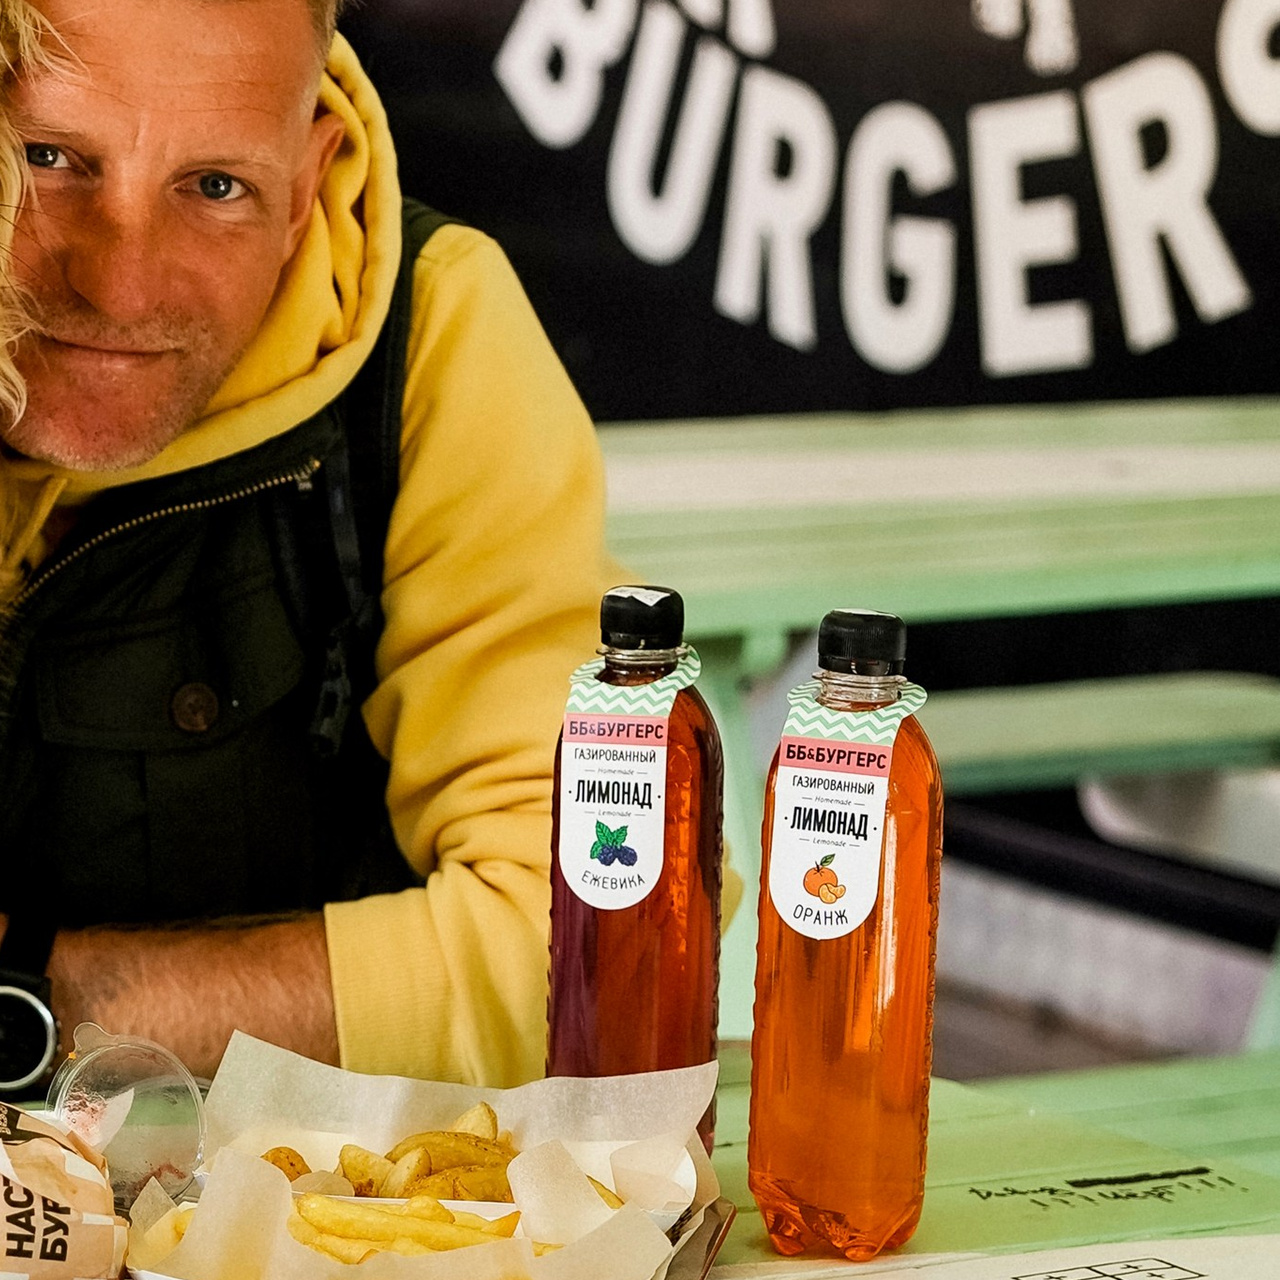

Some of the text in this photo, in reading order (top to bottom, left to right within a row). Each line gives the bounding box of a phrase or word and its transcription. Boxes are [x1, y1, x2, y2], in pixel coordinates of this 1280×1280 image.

[569, 720, 664, 739] ББ&БУРГЕРС
[574, 747, 657, 763] ГАЗИРОВАННЫЙ
[785, 743, 887, 770] ББ&БУРГЕРС
[575, 779, 653, 810] ЛИМОНАД
[792, 774, 875, 795] ГАЗИРОВАННЫЙ
[790, 806, 869, 841] ЛИМОНАД
[581, 870, 646, 891] ЕЖЕВИКА
[792, 903, 849, 926] ОРАНЖ
